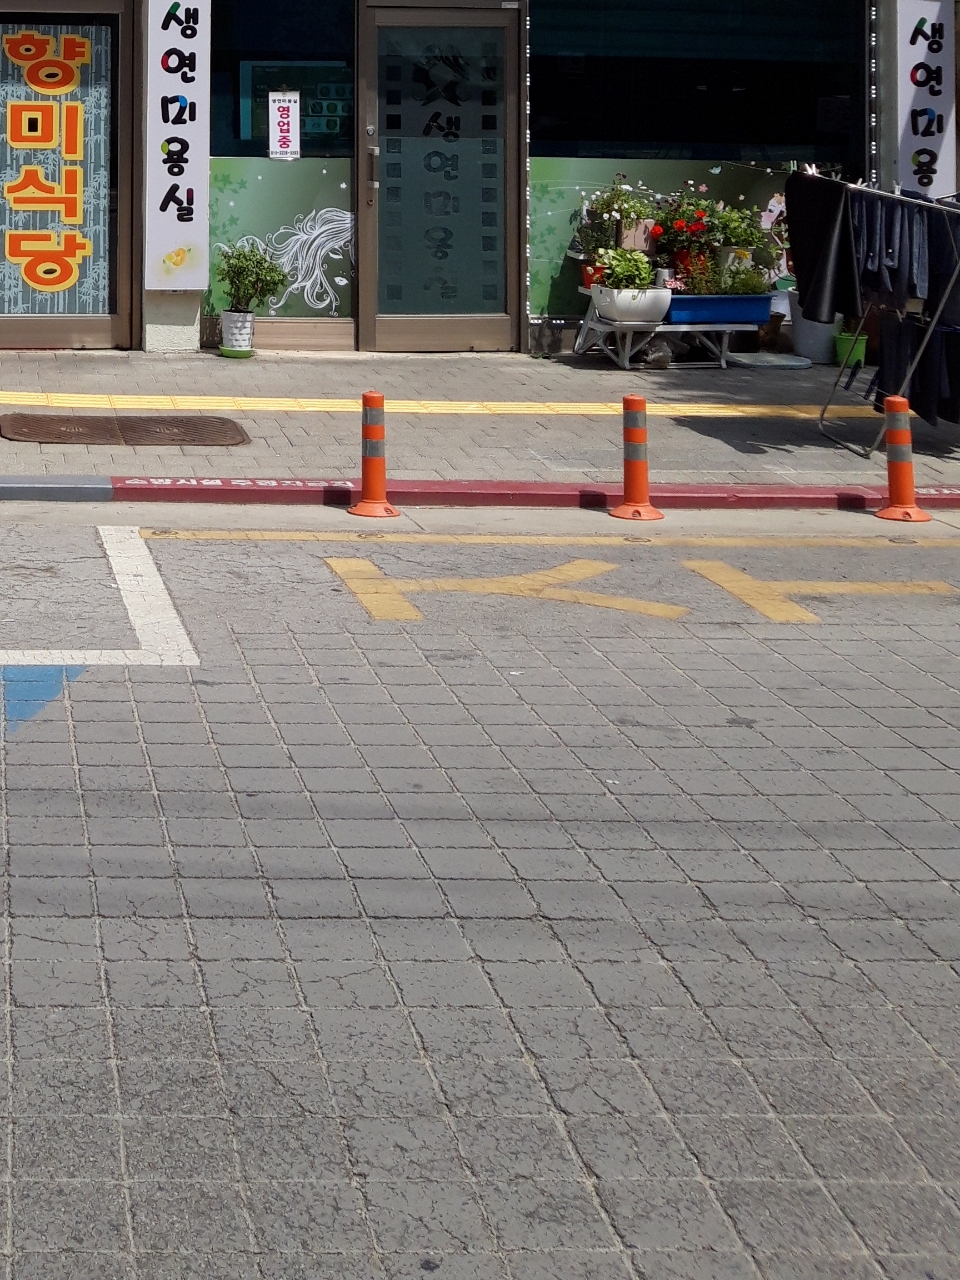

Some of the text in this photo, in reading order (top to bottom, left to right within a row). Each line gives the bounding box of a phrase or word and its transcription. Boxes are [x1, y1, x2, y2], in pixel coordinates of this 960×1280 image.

[2, 30, 92, 292] 향미식당
[159, 1, 199, 223] 생연미용실
[277, 105, 292, 149] 영업중
[423, 111, 461, 300] 생연미용실
